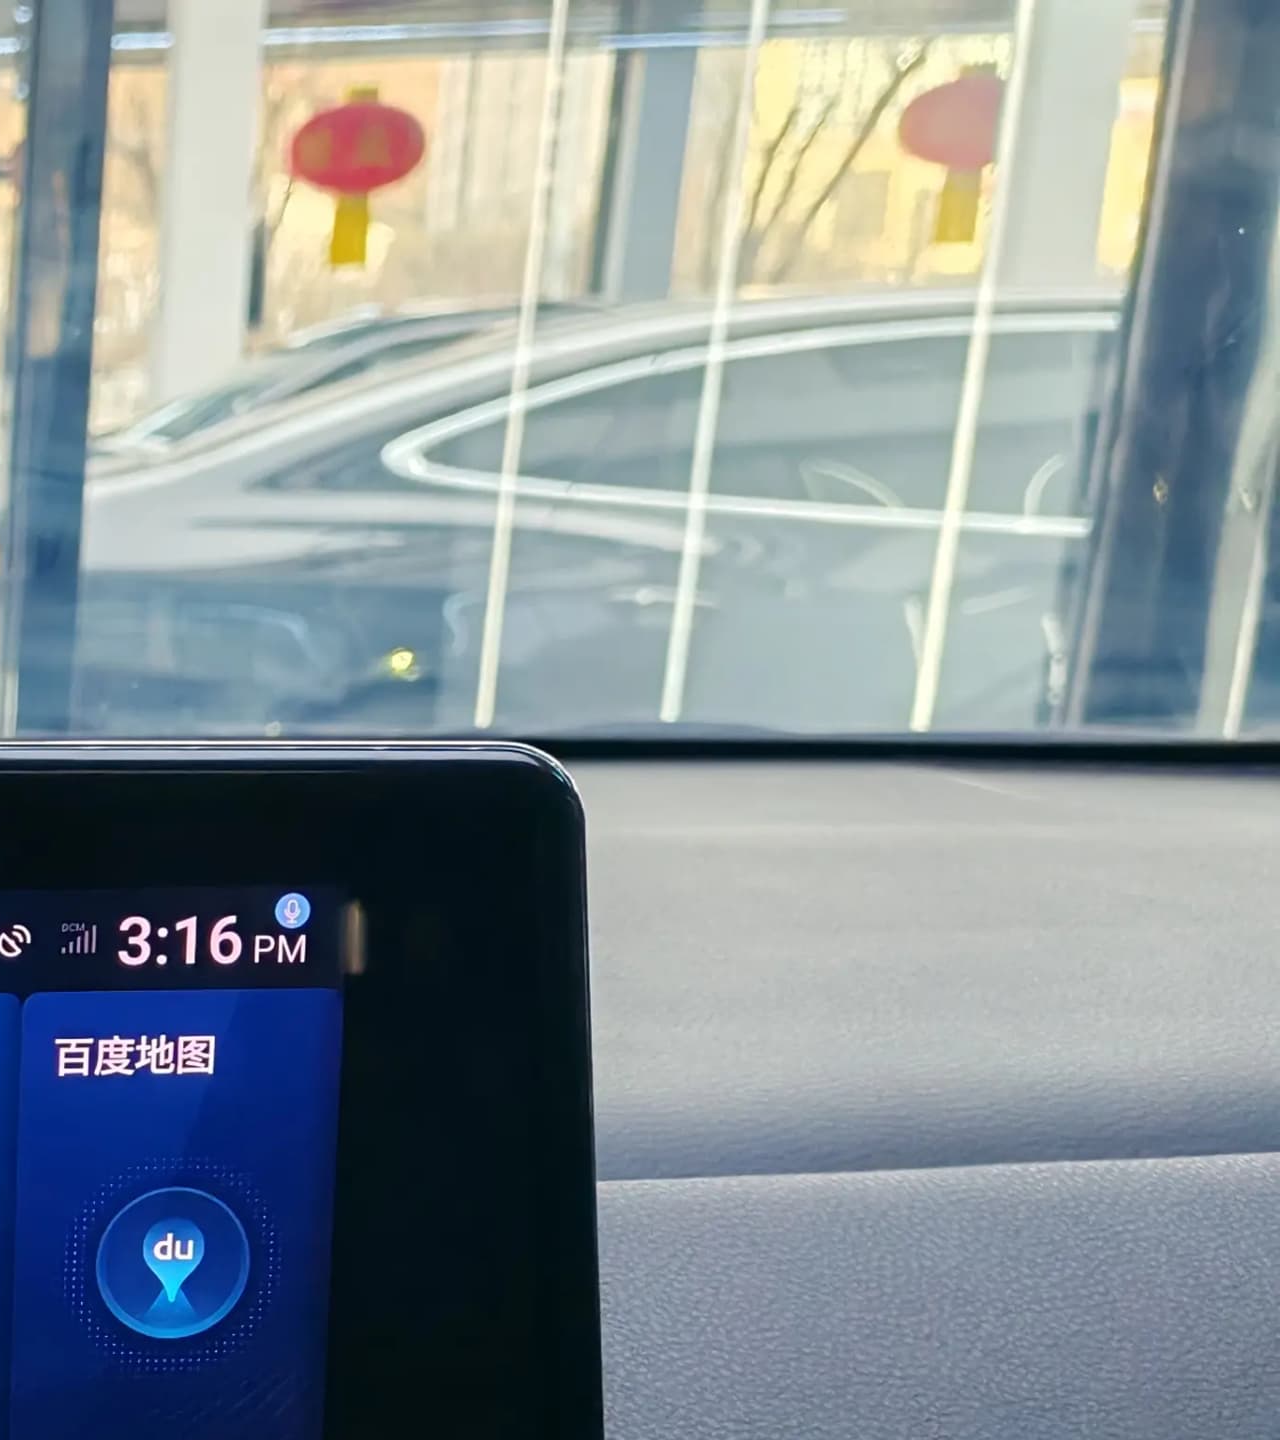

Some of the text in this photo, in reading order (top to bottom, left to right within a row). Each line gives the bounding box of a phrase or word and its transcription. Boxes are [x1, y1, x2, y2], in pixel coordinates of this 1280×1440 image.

[117, 915, 308, 966] 3:16 PM
[53, 1034, 217, 1077] 百度地图
[153, 1232, 195, 1262] du
